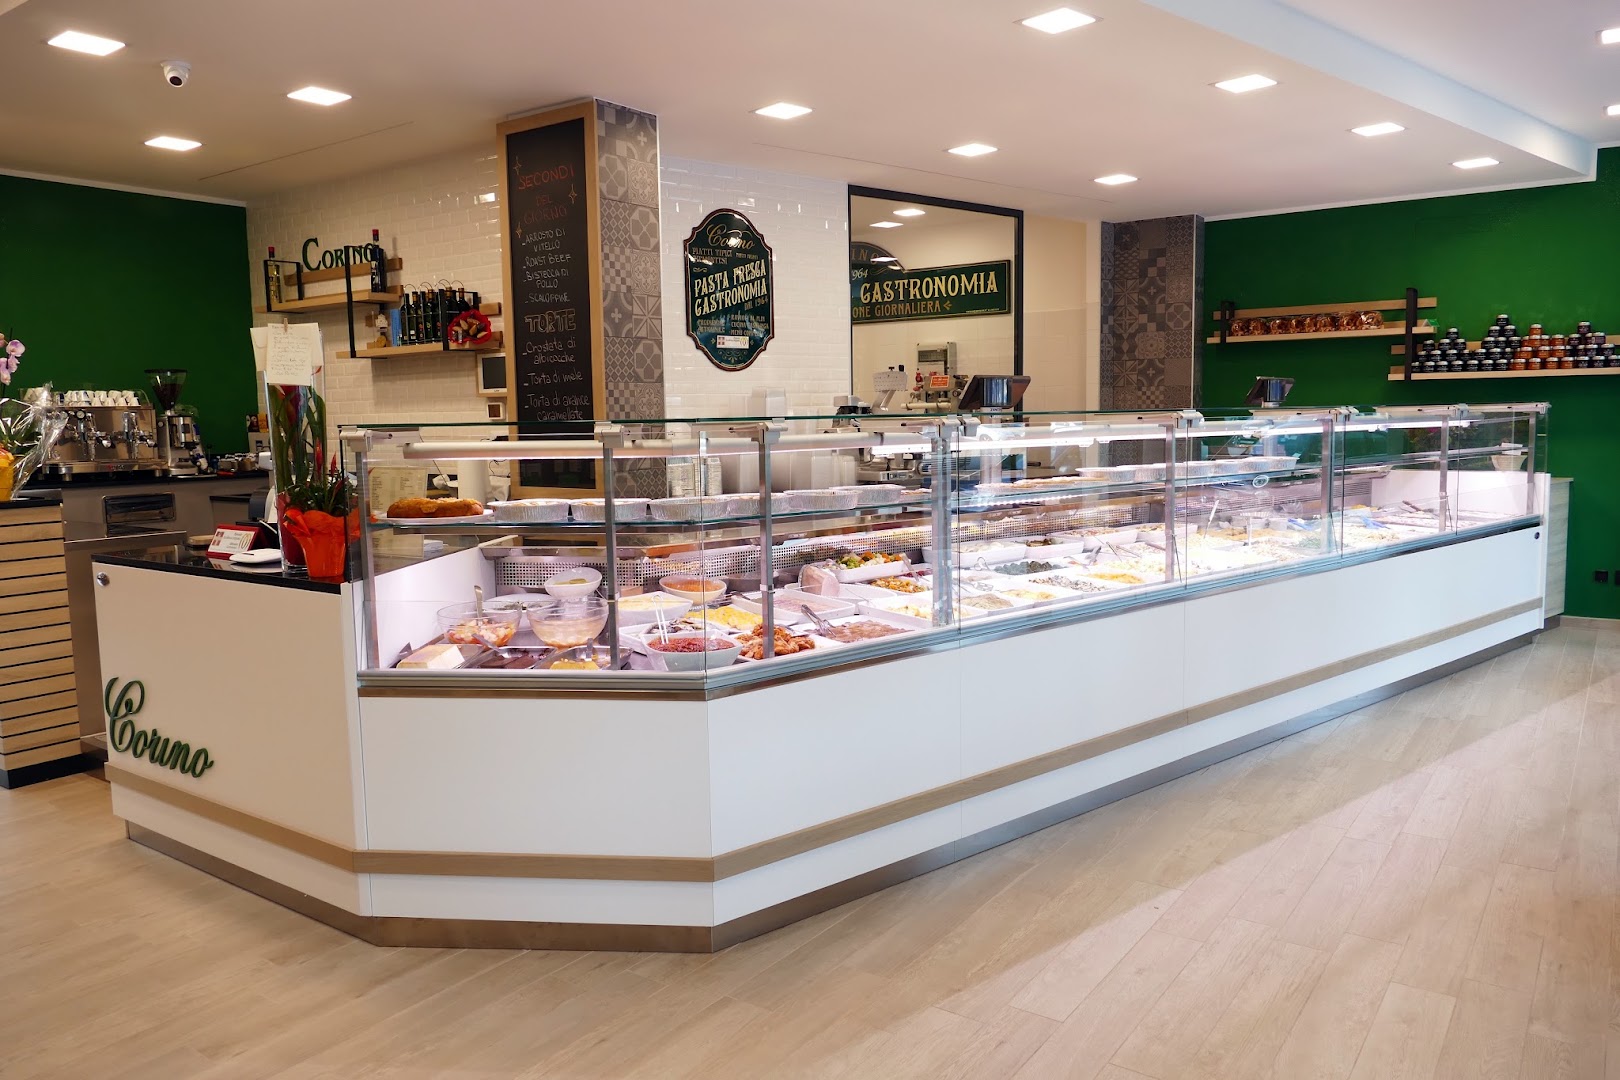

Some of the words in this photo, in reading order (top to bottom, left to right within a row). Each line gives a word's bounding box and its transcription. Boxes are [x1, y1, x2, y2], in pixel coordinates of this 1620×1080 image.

[518, 163, 575, 190] SECONDI
[524, 205, 567, 224] GIORNO
[525, 230, 554, 243] ARROSTO
[555, 228, 566, 237] DI
[533, 240, 561, 252] VITELLO
[692, 247, 713, 256] PIATTI
[525, 256, 546, 268] ROAST
[547, 253, 572, 264] BEEF
[526, 269, 560, 281] BISTECCA
[561, 268, 569, 276] DI
[694, 270, 729, 298] PASTA
[733, 259, 767, 285] FRESCA
[851, 267, 869, 281] 964
[536, 279, 559, 288] POLLO
[860, 271, 999, 304] GASTRONOMIA
[694, 278, 768, 317] GASTRONOMIA
[852, 305, 871, 318] ONE
[874, 300, 941, 317] GIORNALIERA
[524, 308, 576, 333] TORTE
[526, 339, 563, 353] Crostata
[567, 336, 576, 348] di
[534, 352, 576, 364] albicocche
[527, 372, 551, 385] Torta
[552, 370, 561, 383] di
[562, 367, 583, 383] mele
[527, 393, 550, 407] Torta
[552, 390, 561, 406] di
[563, 395, 590, 407] arance
[537, 407, 584, 421] caramellate
[104, 676, 215, 779] Corino
